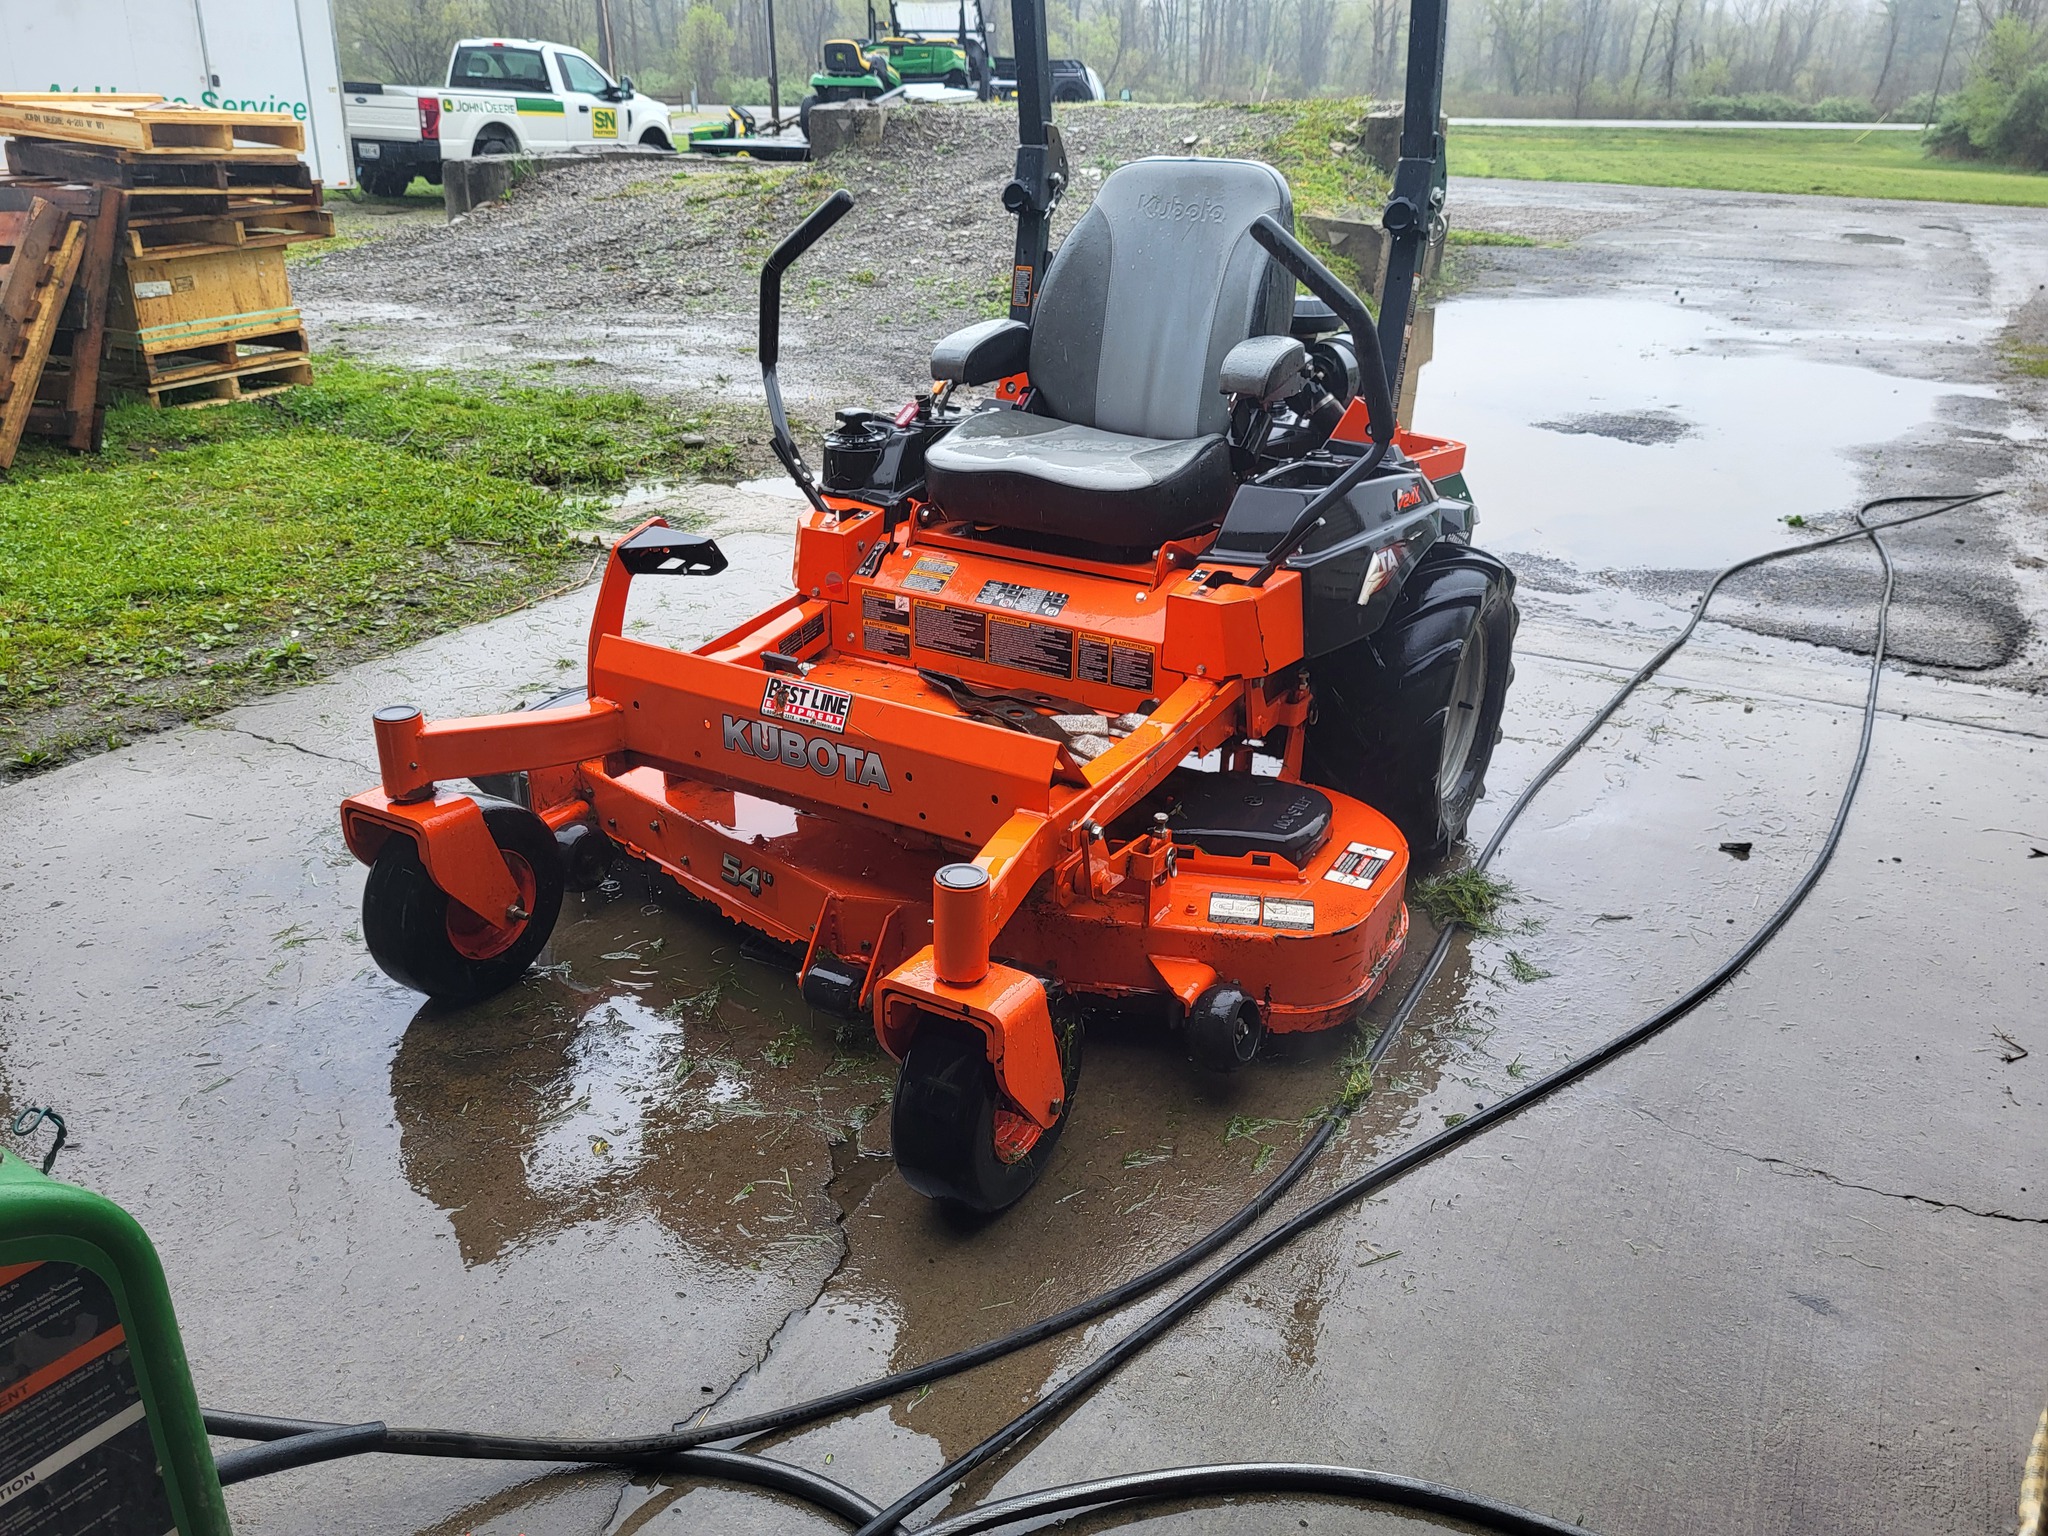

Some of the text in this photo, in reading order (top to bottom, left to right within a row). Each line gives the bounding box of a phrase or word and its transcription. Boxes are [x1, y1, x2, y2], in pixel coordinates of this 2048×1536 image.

[456, 101, 516, 114] JOHN DEERE
[1137, 194, 1226, 223] Kubota
[766, 700, 842, 724] EUIPMENT
[767, 679, 849, 716] BST LINE
[722, 714, 893, 794] KUBOTA
